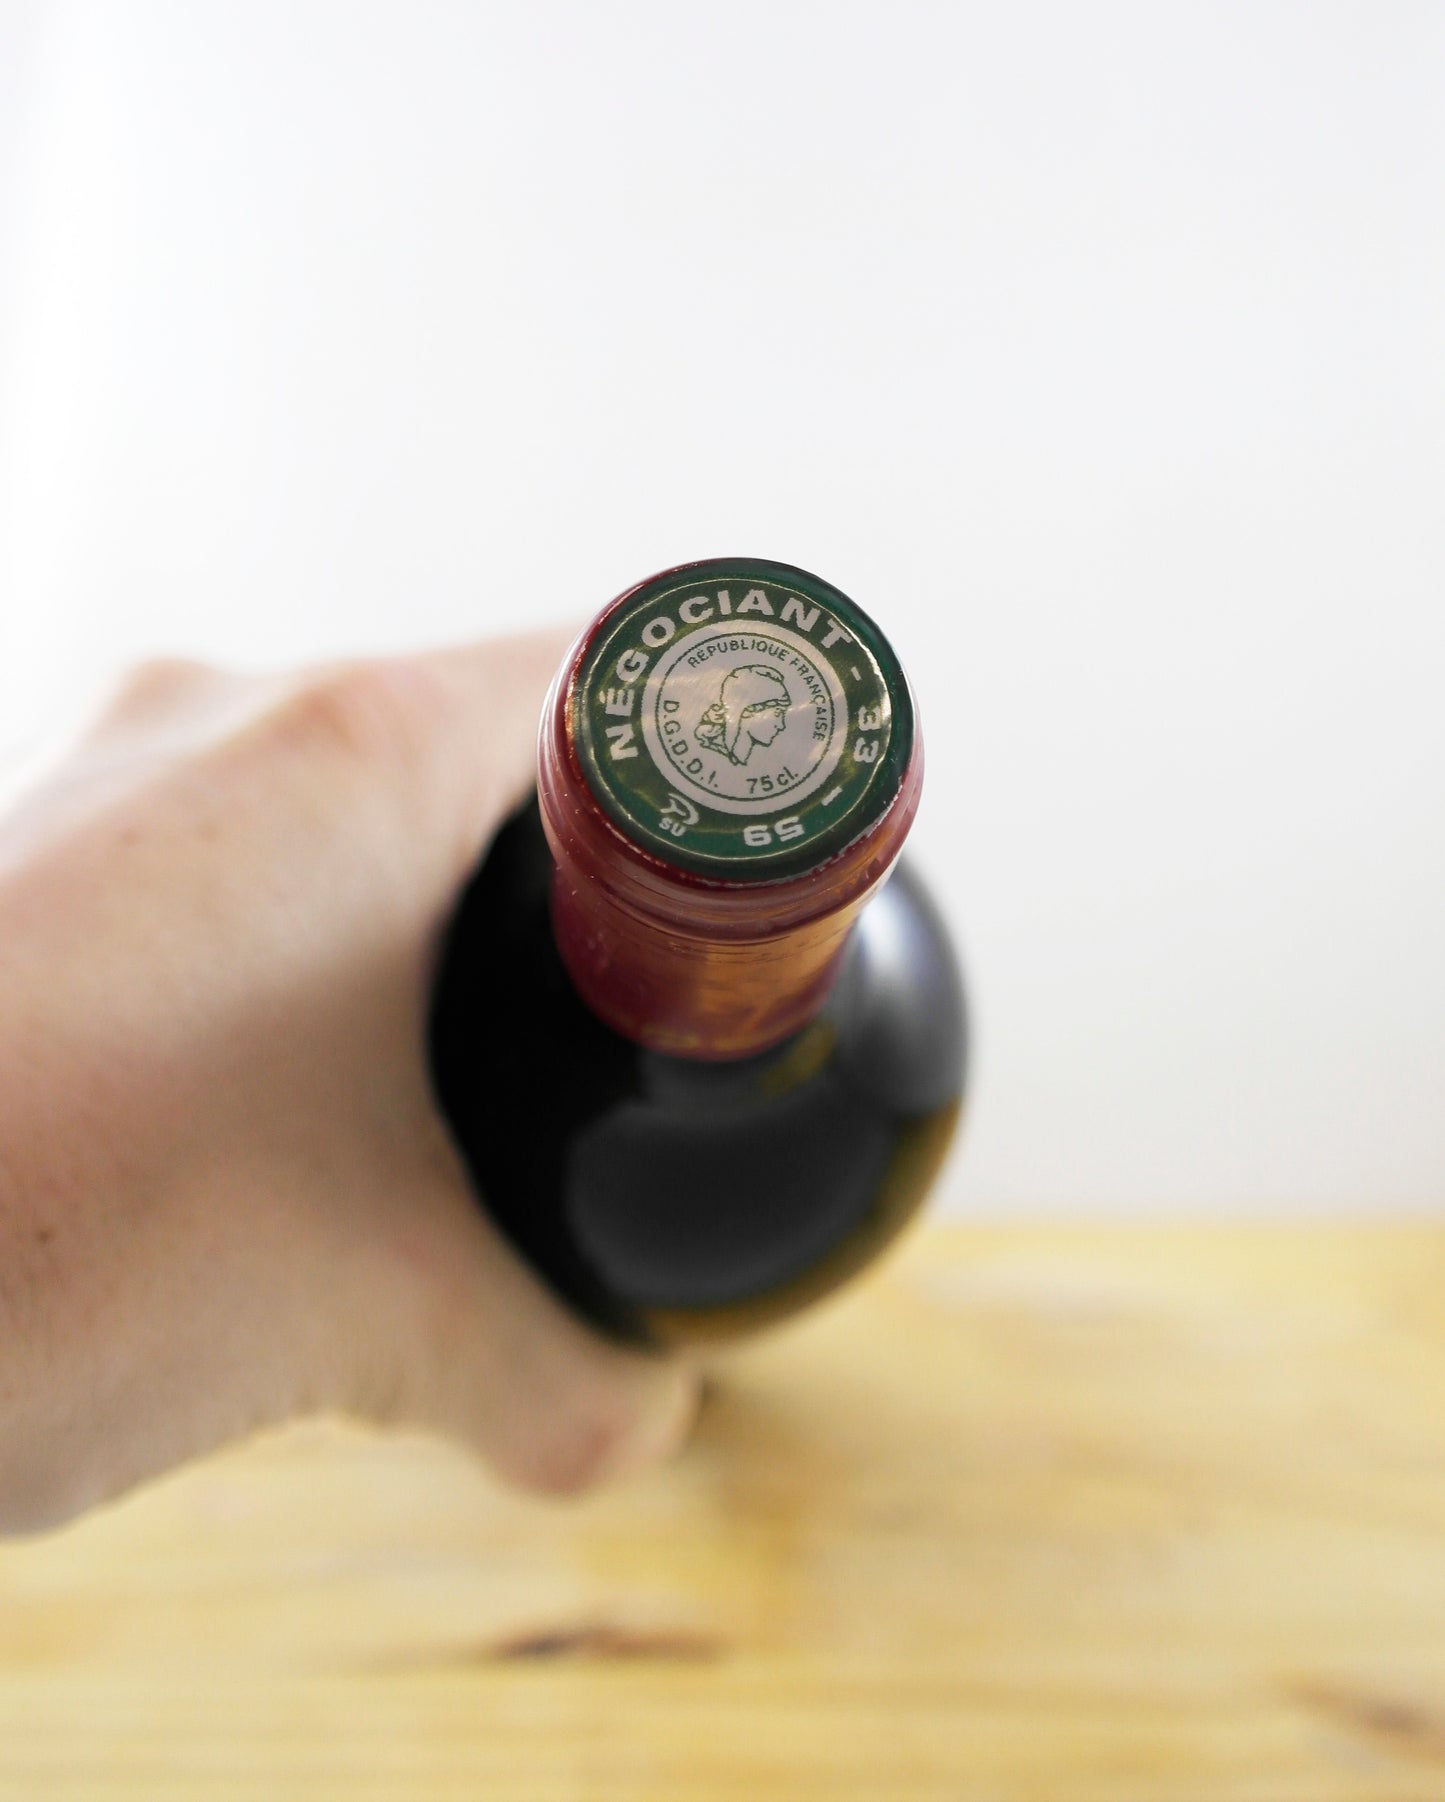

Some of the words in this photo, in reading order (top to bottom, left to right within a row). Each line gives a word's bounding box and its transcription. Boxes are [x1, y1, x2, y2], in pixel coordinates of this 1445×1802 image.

[599, 588, 855, 761] NÉGOCIANT
[687, 638, 790, 668] REPUBLIQUE
[788, 657, 828, 741] FRANÇAISE
[663, 699, 719, 788] D.G.D.D.I.
[852, 705, 882, 763] 33
[743, 815, 805, 847] 59
